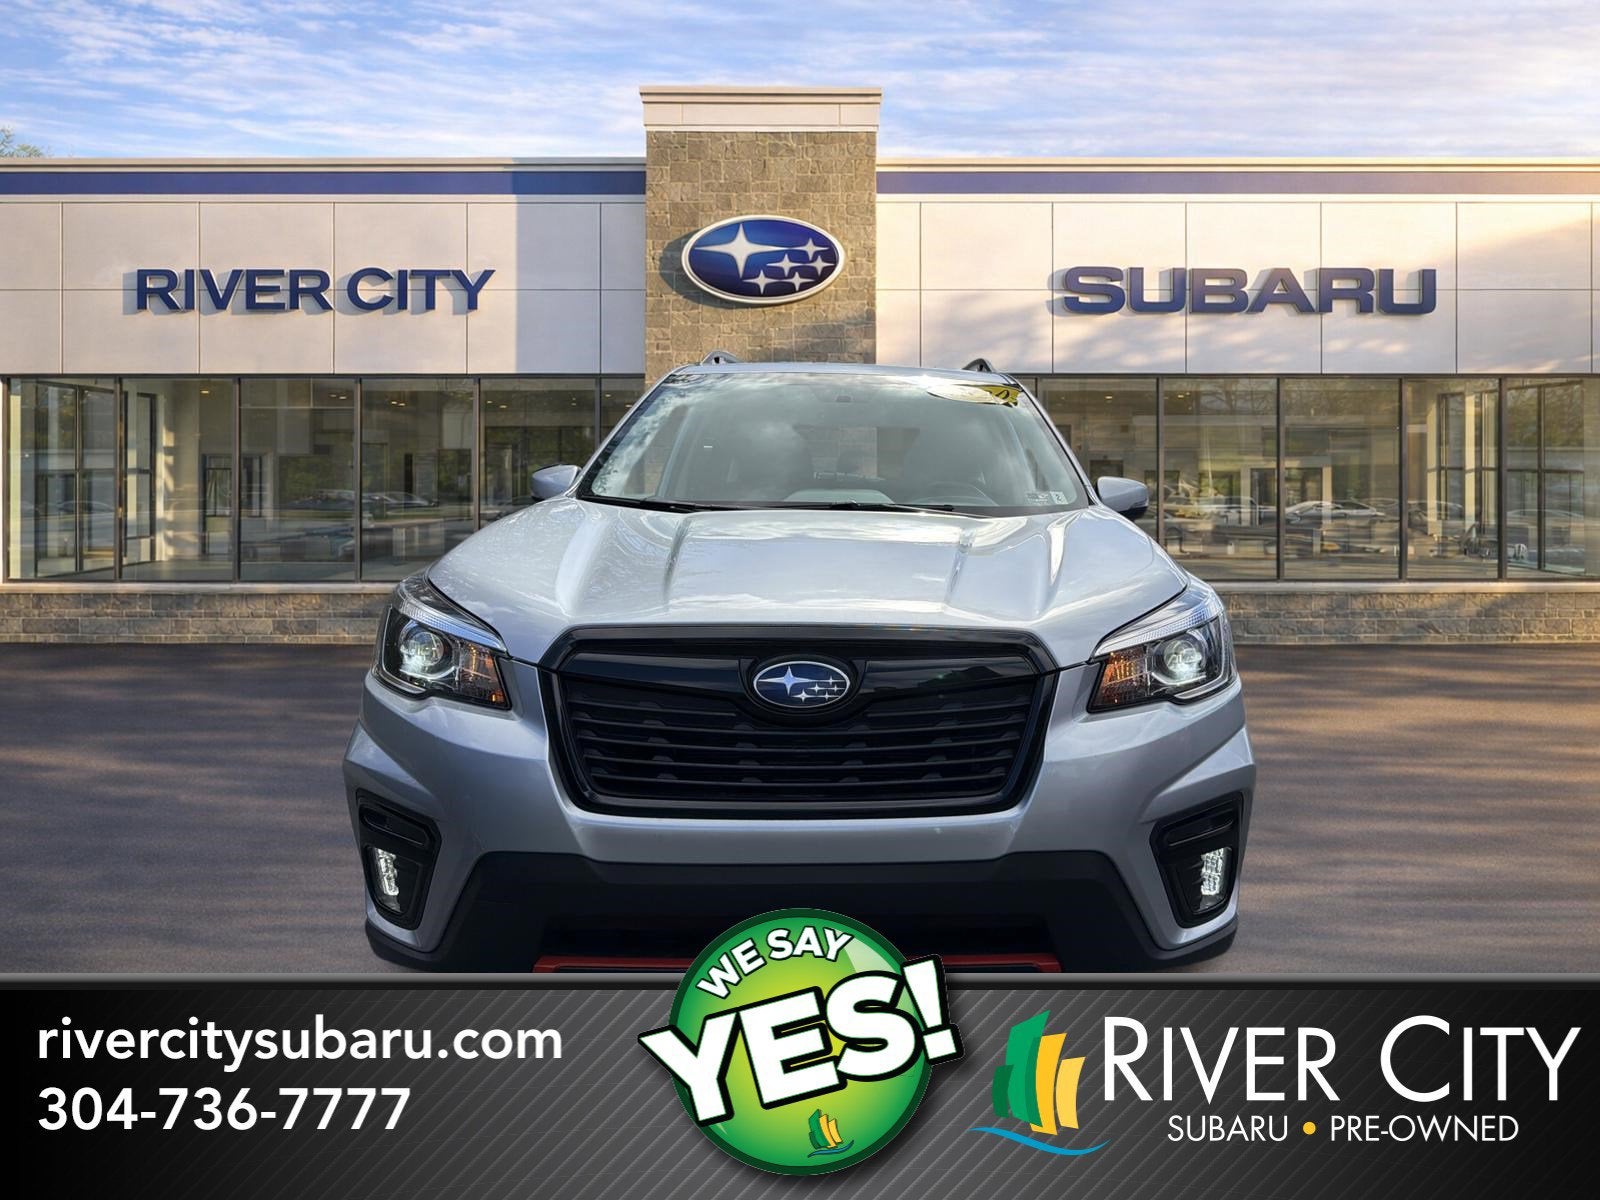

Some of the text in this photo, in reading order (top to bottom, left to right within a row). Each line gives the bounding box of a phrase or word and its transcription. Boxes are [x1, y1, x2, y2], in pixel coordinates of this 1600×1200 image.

[136, 266, 496, 312] RIVER CITY
[1062, 266, 1437, 315] SUBARU
